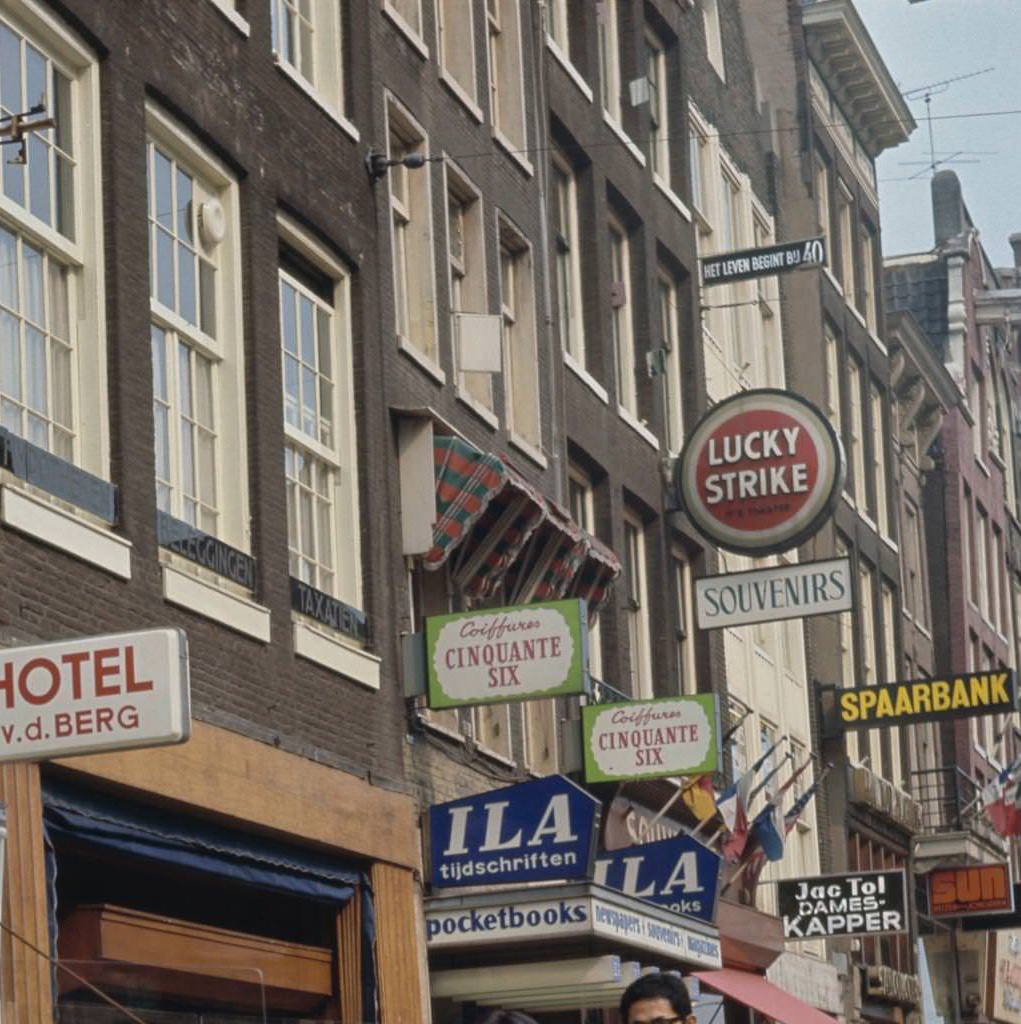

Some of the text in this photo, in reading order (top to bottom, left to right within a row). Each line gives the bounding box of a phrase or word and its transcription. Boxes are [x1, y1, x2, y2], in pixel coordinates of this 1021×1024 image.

[703, 261, 721, 279] HET
[722, 257, 750, 276] LEVEN
[751, 251, 785, 272] BEGINT
[708, 426, 801, 467] LUCKY
[705, 463, 809, 505] STRIKE
[703, 569, 846, 617] SOUVENIRS
[459, 615, 541, 641] Coiffures
[445, 635, 562, 671] CINQUANTE
[487, 665, 521, 688] SIX
[840, 673, 1010, 723] SPAARBANK
[611, 706, 682, 728] Coiffures
[598, 723, 700, 752] CINQUANTE
[634, 747, 664, 767] SIX
[443, 793, 579, 857] ILA
[439, 850, 578, 882] tijdschriften
[593, 851, 705, 898] ILA
[794, 875, 886, 901] Jac Tol
[428, 900, 588, 941] pocketbooks
[798, 895, 886, 917] DAMES-
[783, 909, 902, 938] KAPPER
